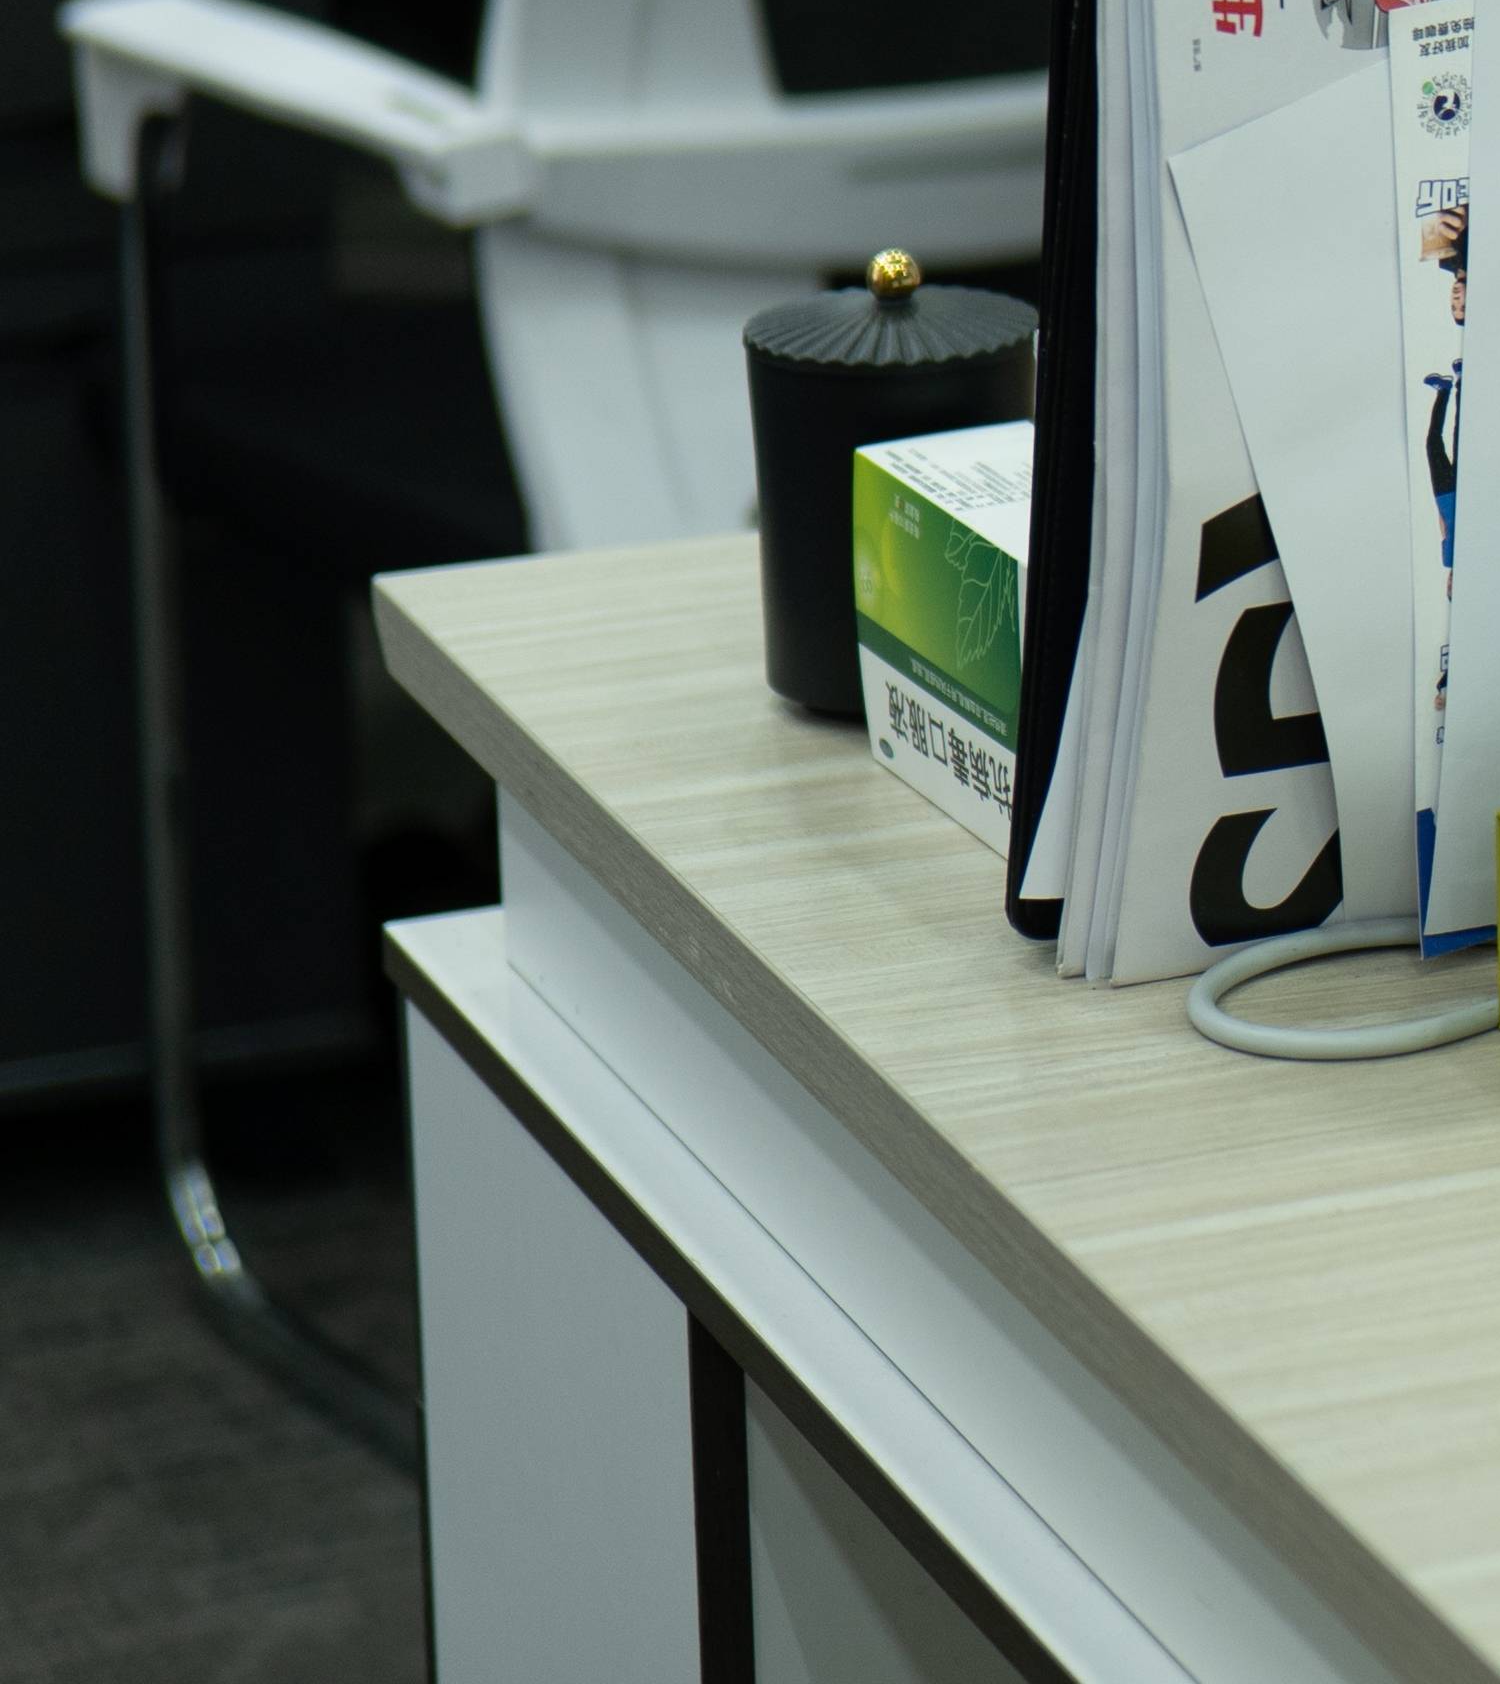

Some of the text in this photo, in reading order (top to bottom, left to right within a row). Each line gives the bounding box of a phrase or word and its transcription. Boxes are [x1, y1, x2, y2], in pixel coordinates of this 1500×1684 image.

[1420, 34, 1470, 57] 加我好友
[885, 680, 1012, 822] 抗病毒口服液
